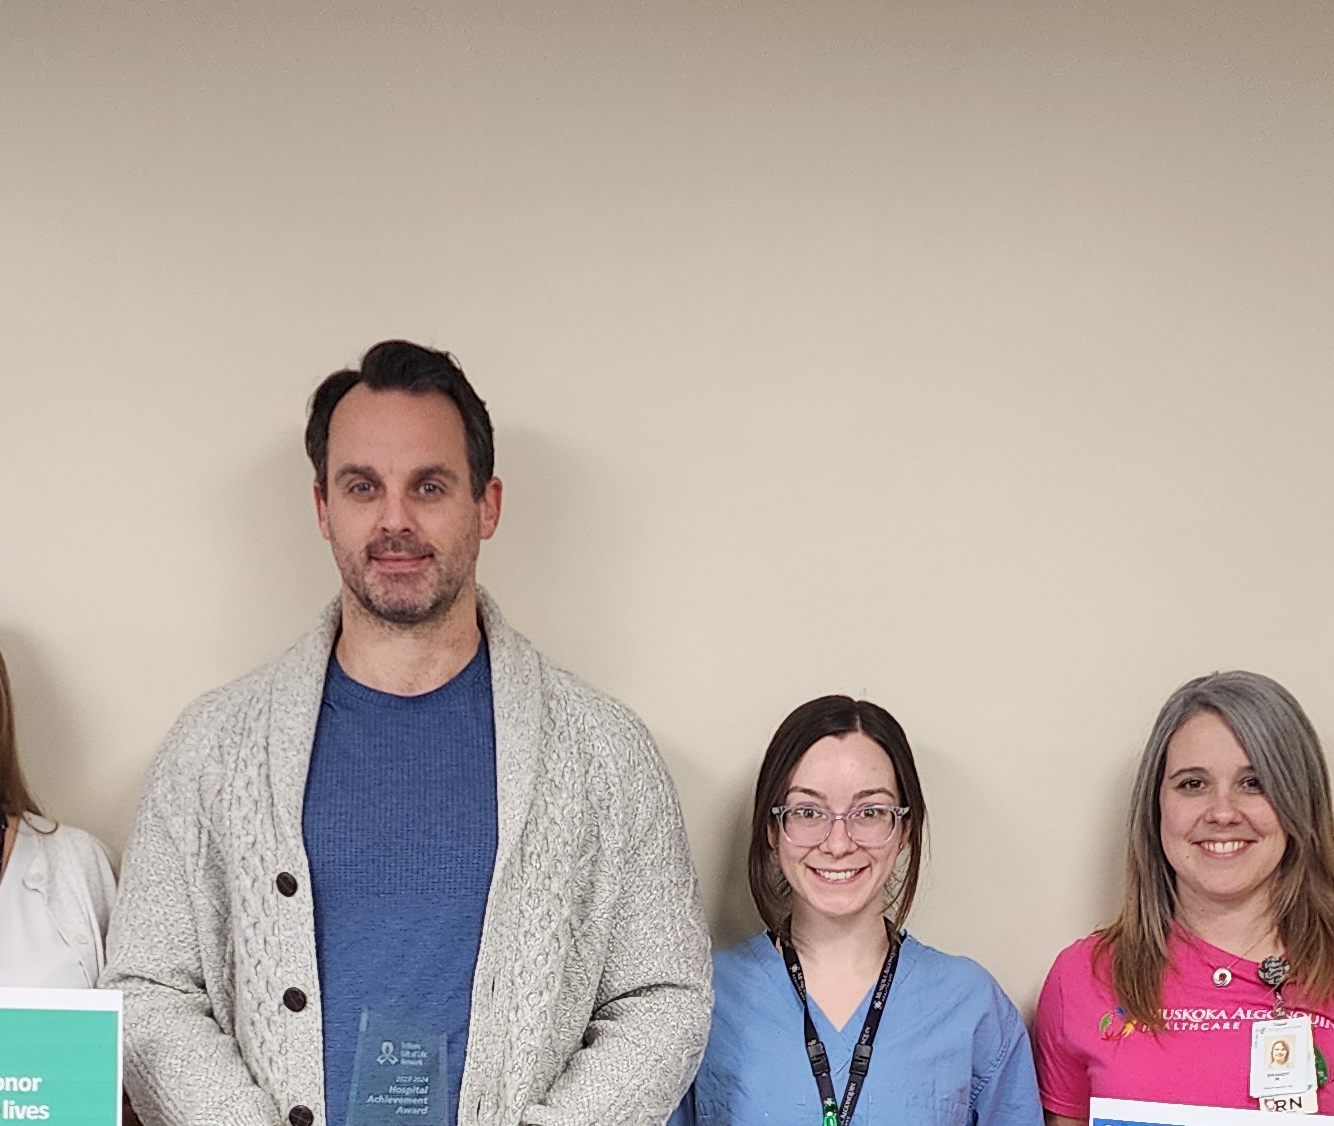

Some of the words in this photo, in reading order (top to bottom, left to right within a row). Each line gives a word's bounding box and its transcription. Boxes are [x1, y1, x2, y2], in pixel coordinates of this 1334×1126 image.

[388, 1085, 430, 1096] Hospital
[367, 1094, 429, 1105] Achievement
[1274, 1096, 1303, 1112] RN
[2, 1099, 51, 1120] lives
[395, 1106, 429, 1115] Award
